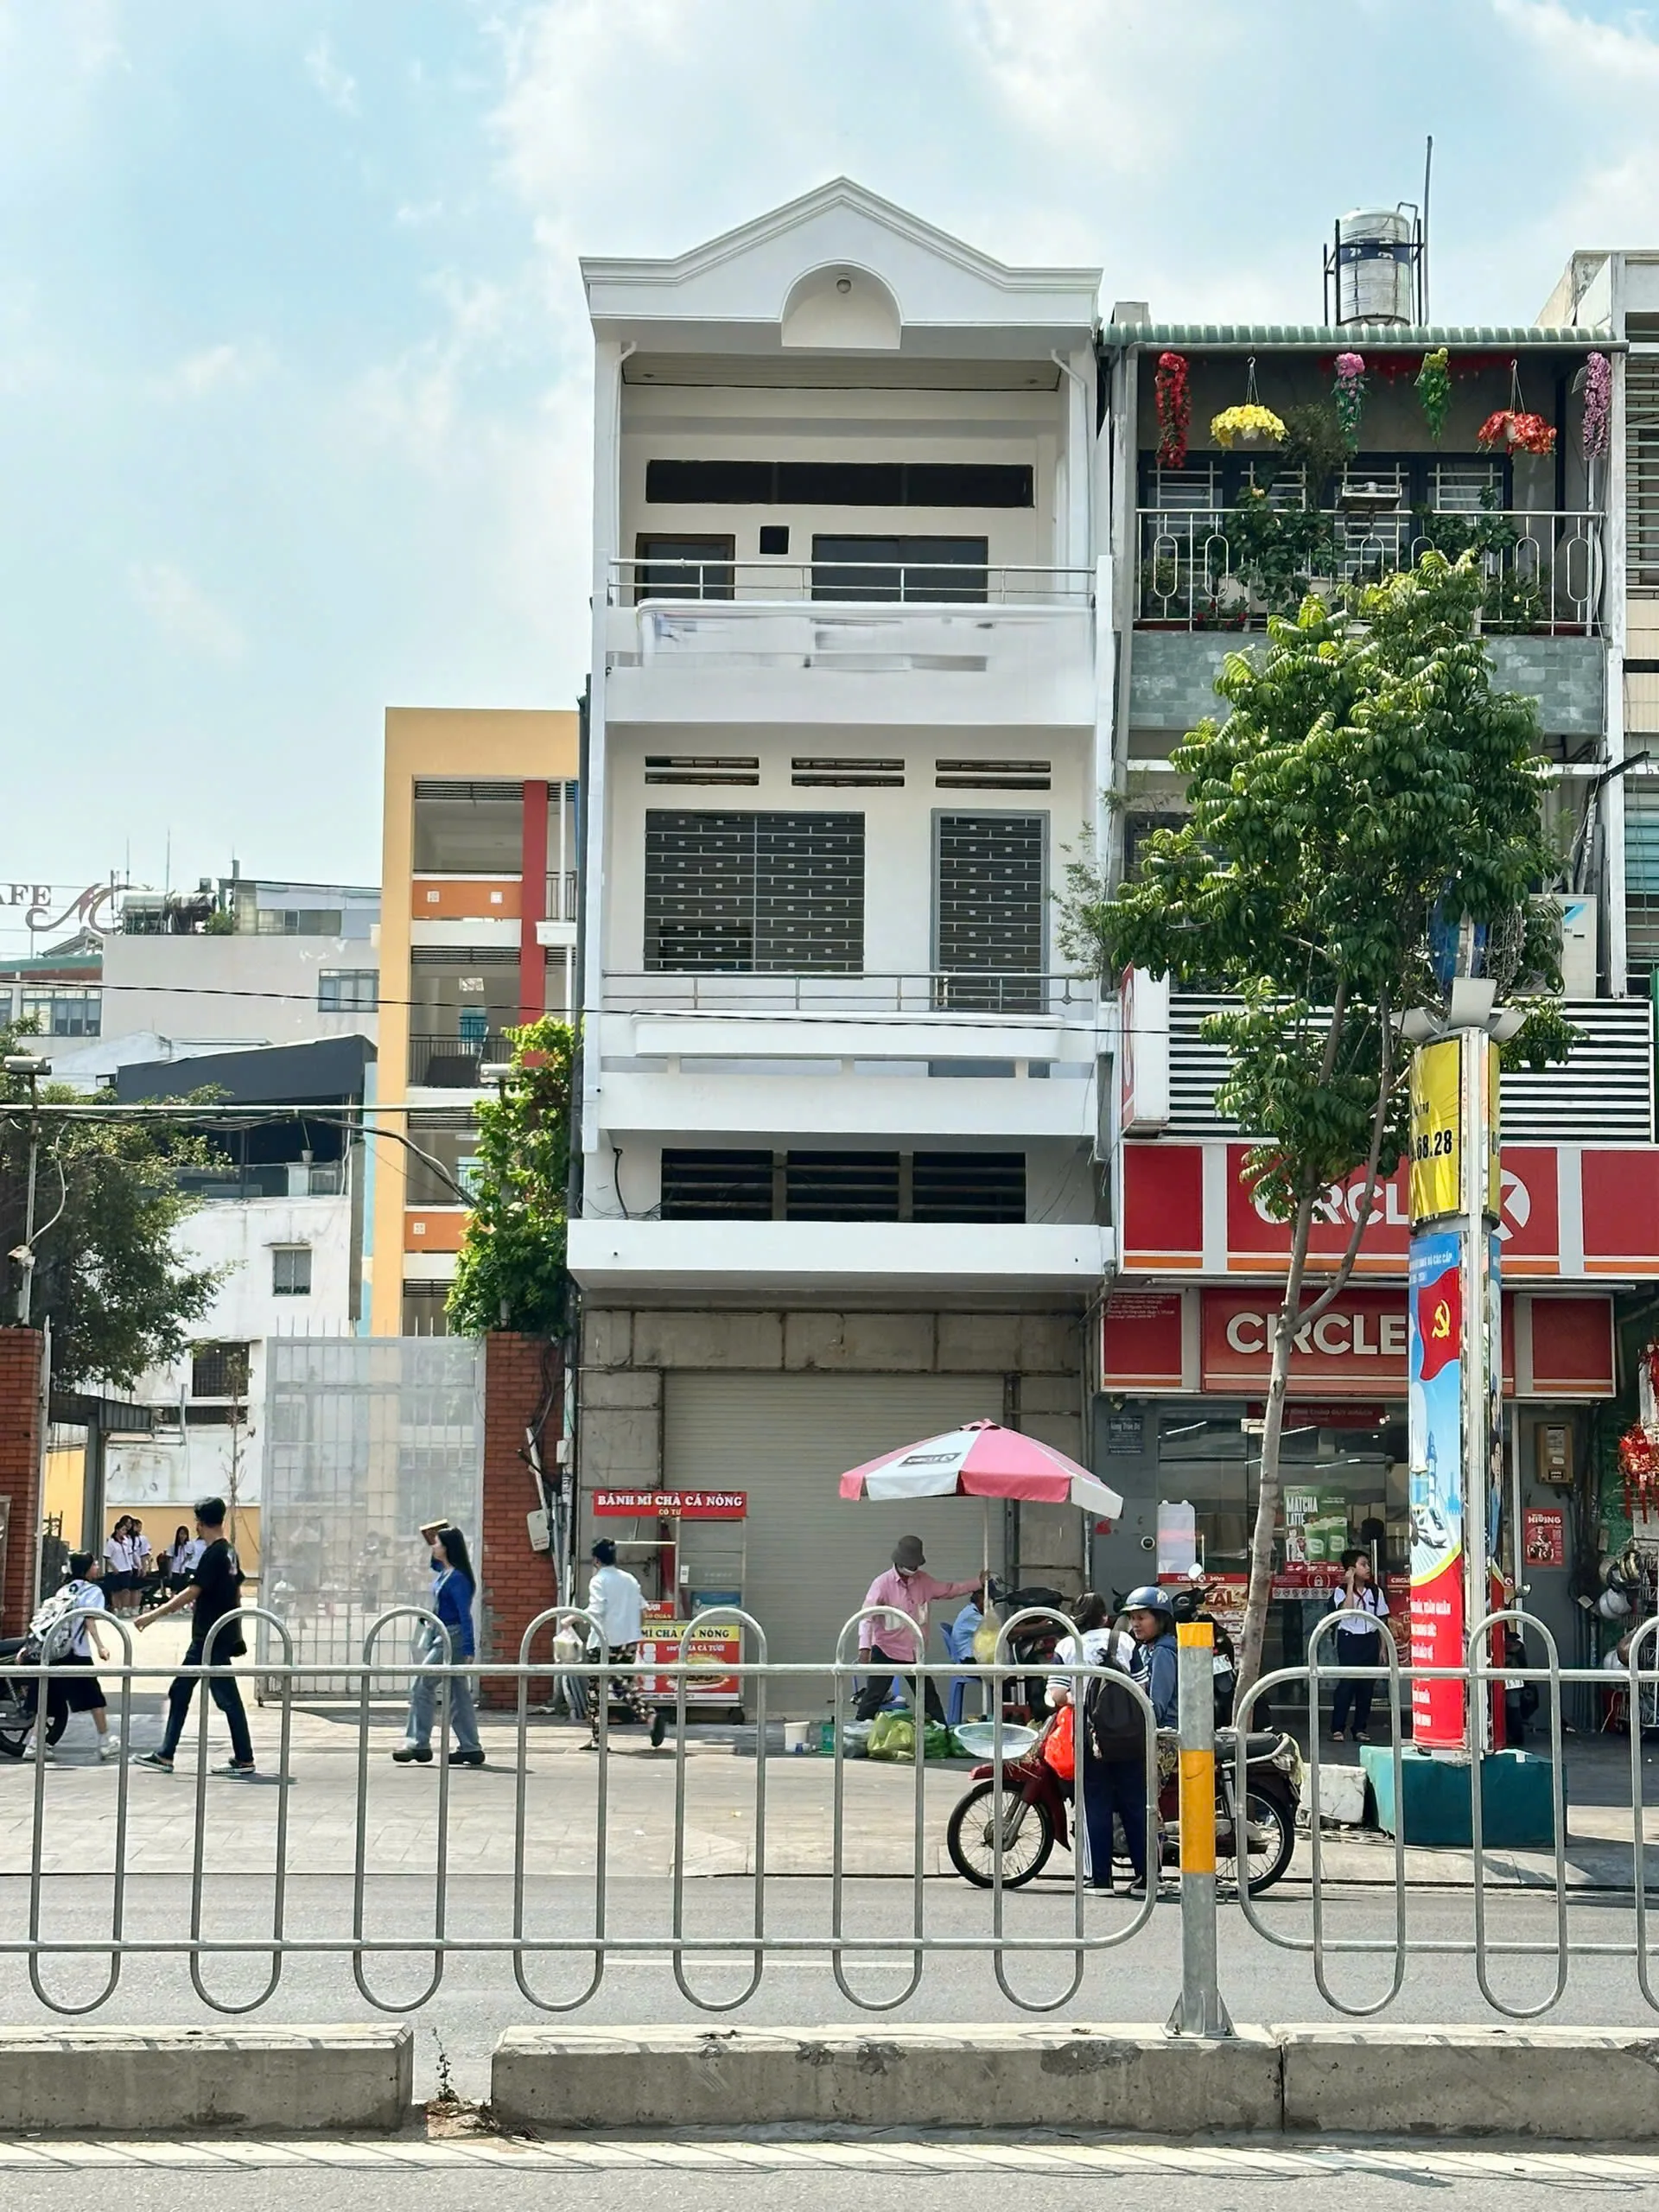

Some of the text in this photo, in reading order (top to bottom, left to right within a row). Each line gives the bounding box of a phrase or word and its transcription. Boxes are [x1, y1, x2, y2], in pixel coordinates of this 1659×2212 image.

[598, 1492, 634, 1506] BÁNH
[685, 1493, 702, 1507] CÁ
[706, 1493, 742, 1507] NÓNG
[1286, 1497, 1319, 1513] MATCHA
[1205, 1590, 1237, 1606] EAL
[699, 1627, 729, 1638] NÓNG
